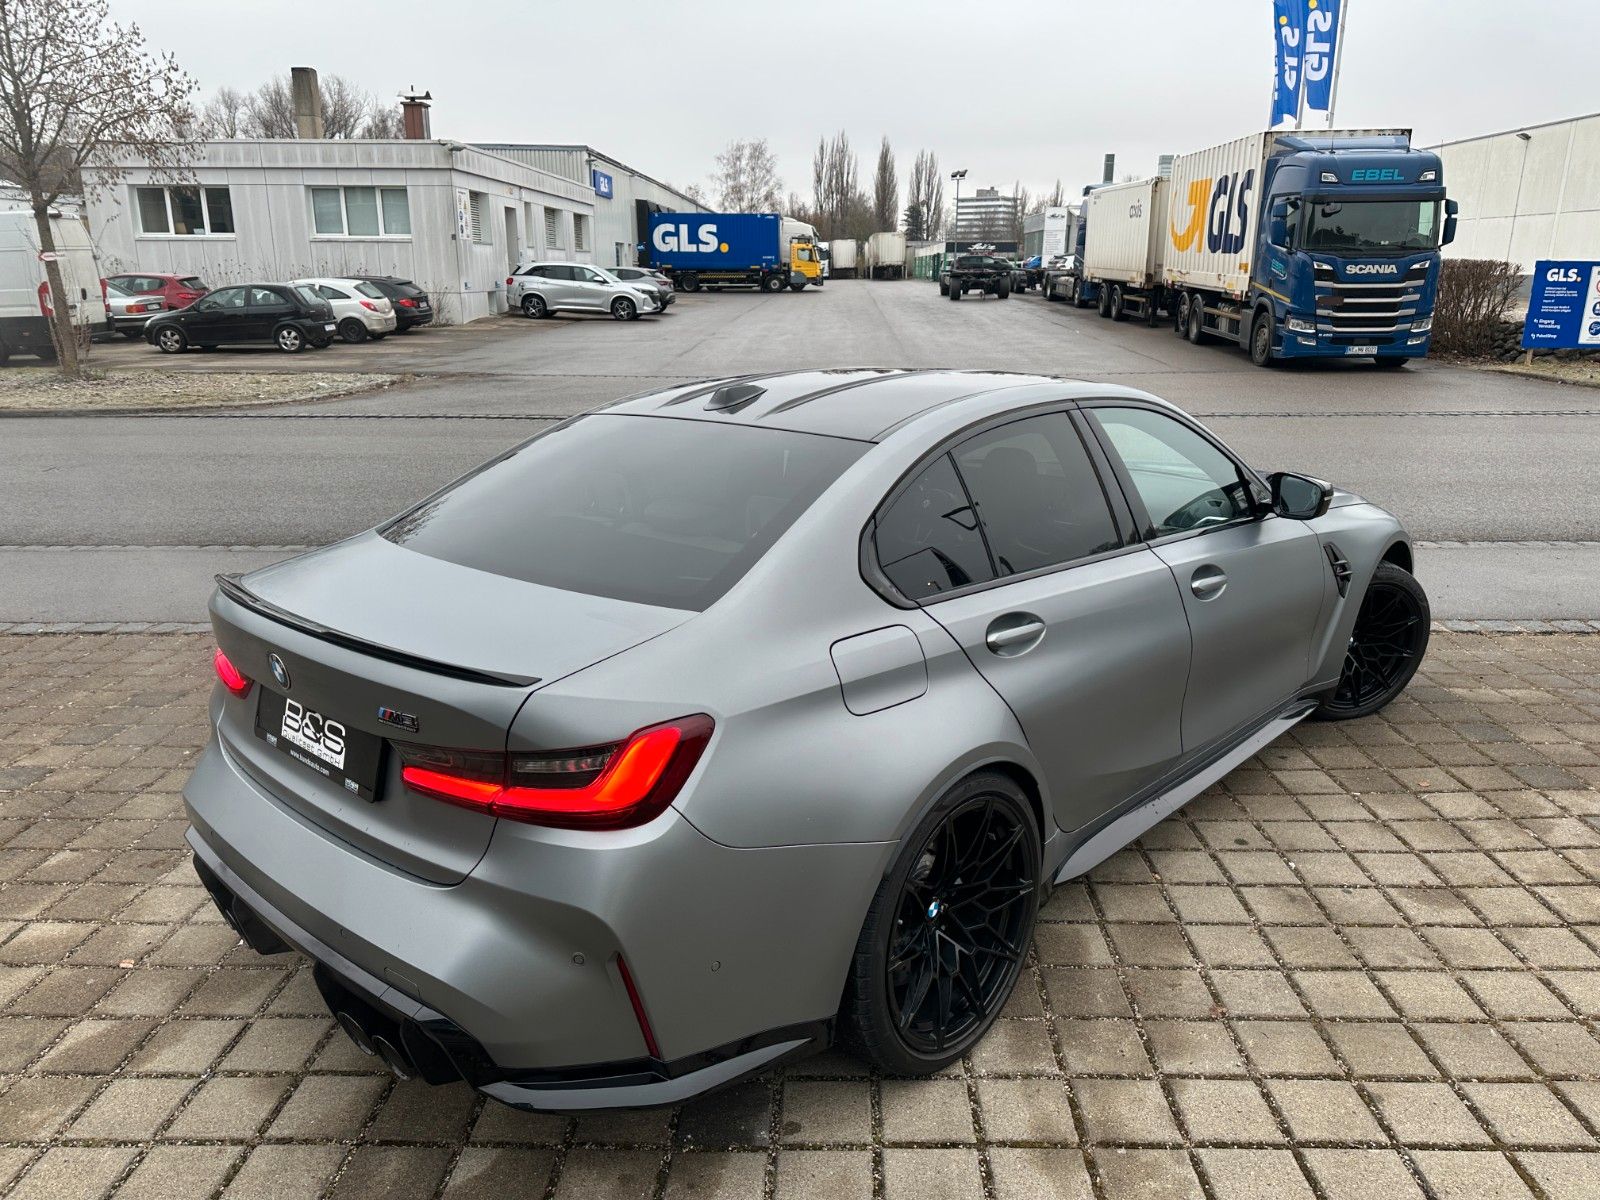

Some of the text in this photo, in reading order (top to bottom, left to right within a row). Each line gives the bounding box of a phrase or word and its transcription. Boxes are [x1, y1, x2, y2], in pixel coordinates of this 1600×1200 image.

[1352, 168, 1405, 181] EBEL
[1207, 168, 1256, 255] GLS
[1345, 264, 1398, 275] SCANIA
[283, 698, 346, 756] B&S
[317, 747, 341, 768] GmbH
